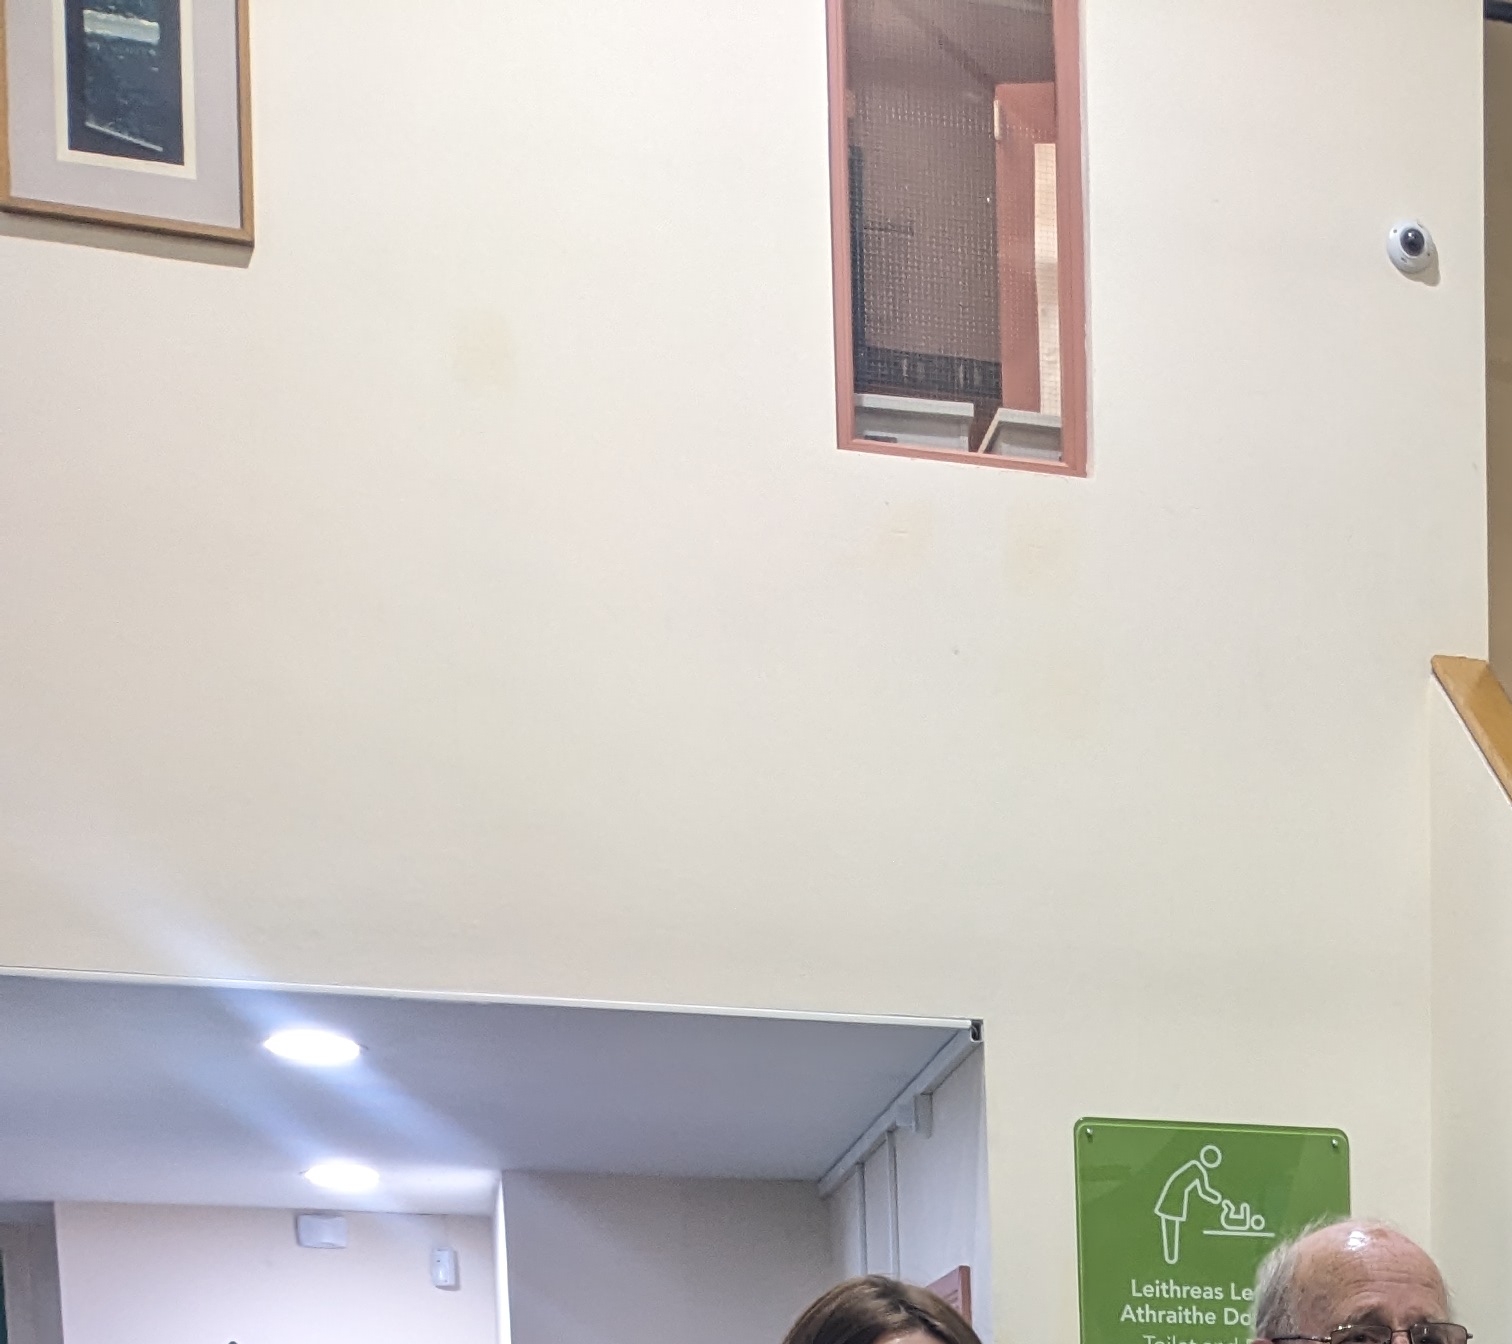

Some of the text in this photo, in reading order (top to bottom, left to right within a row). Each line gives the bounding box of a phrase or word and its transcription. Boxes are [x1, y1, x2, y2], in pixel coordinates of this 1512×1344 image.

[1131, 1279, 1253, 1301] Leithreas Le
[1120, 1304, 1251, 1327] Athraithe Do
